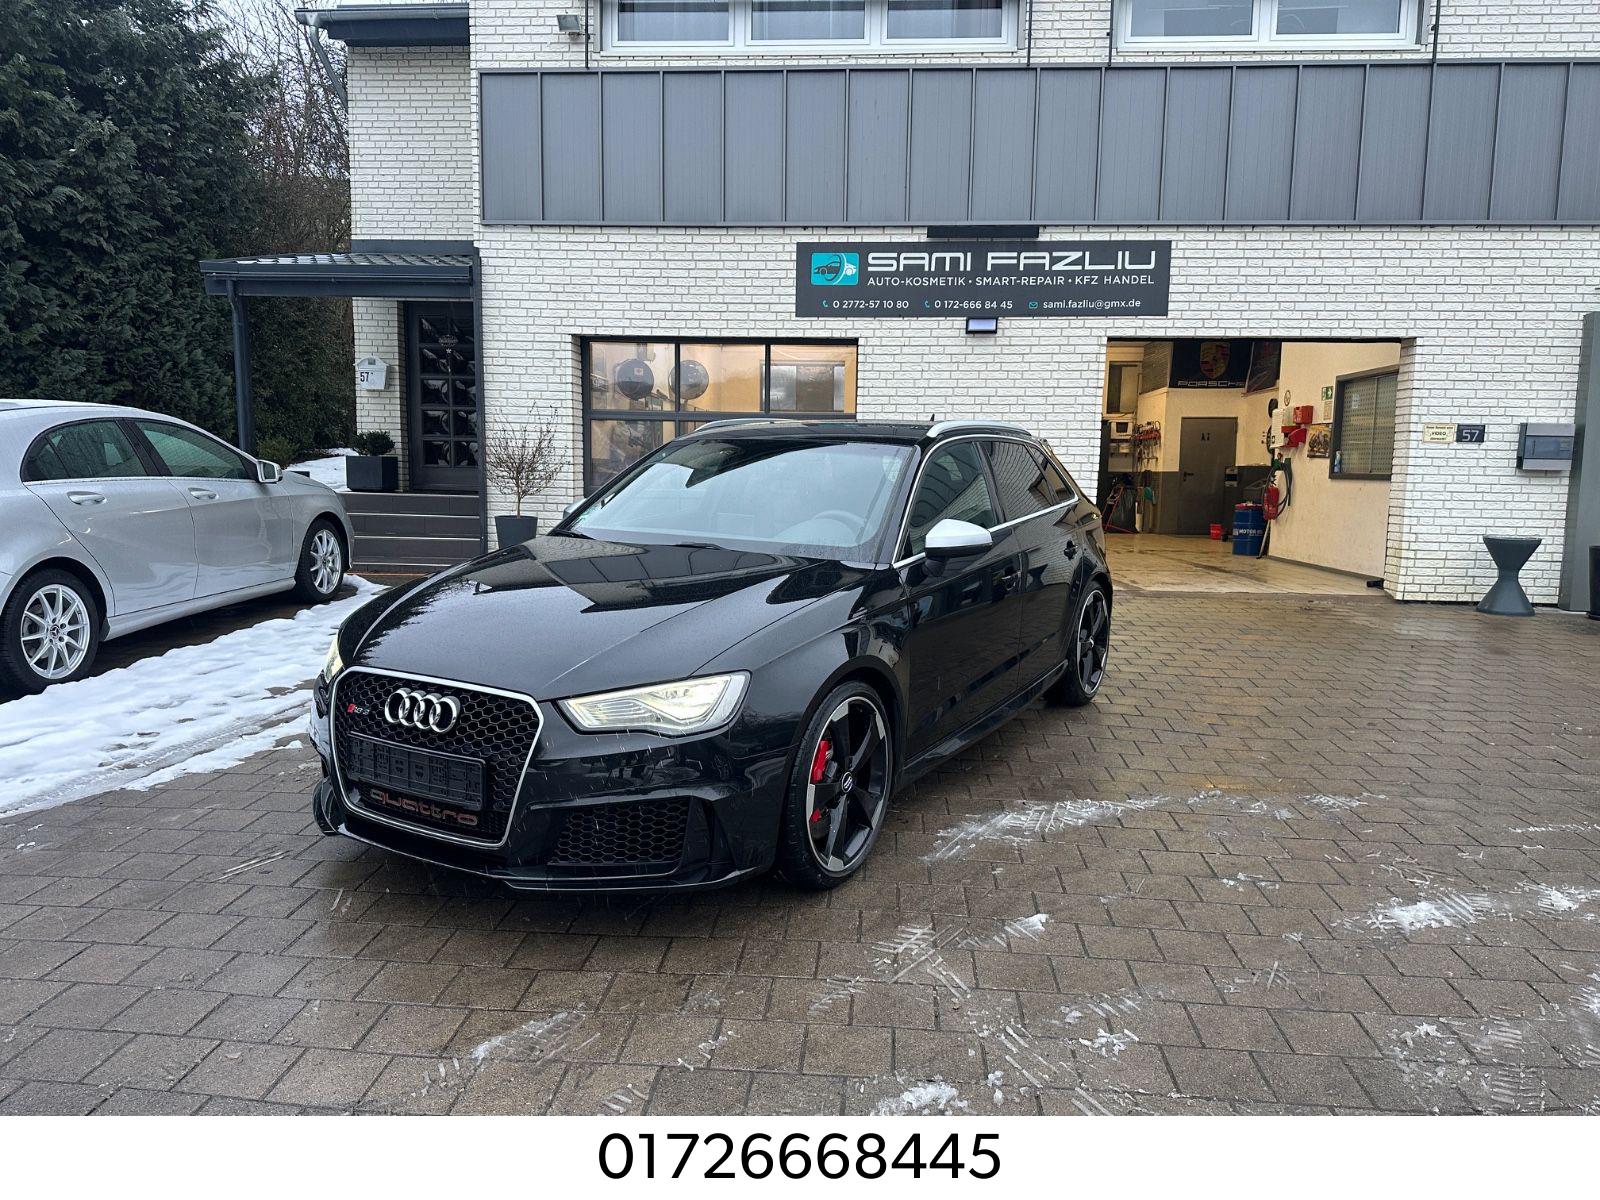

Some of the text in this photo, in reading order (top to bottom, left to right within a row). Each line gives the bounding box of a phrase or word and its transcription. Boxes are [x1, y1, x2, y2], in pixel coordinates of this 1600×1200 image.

[867, 250, 1156, 272] SAMI FAZLIU
[867, 274, 1155, 287] AUTO-KOSMETIK SMART-REPAIR KFZ HANDEL
[842, 300, 880, 309] 2772-57
[883, 300, 893, 309] 10
[896, 300, 909, 309] 80
[944, 300, 982, 309] 172-666
[984, 300, 998, 309] 84
[1000, 300, 1013, 309] 45
[1043, 298, 1141, 310] sami.fazliu@gmx.de
[1462, 430, 1479, 441] 57
[370, 788, 478, 826] quattro
